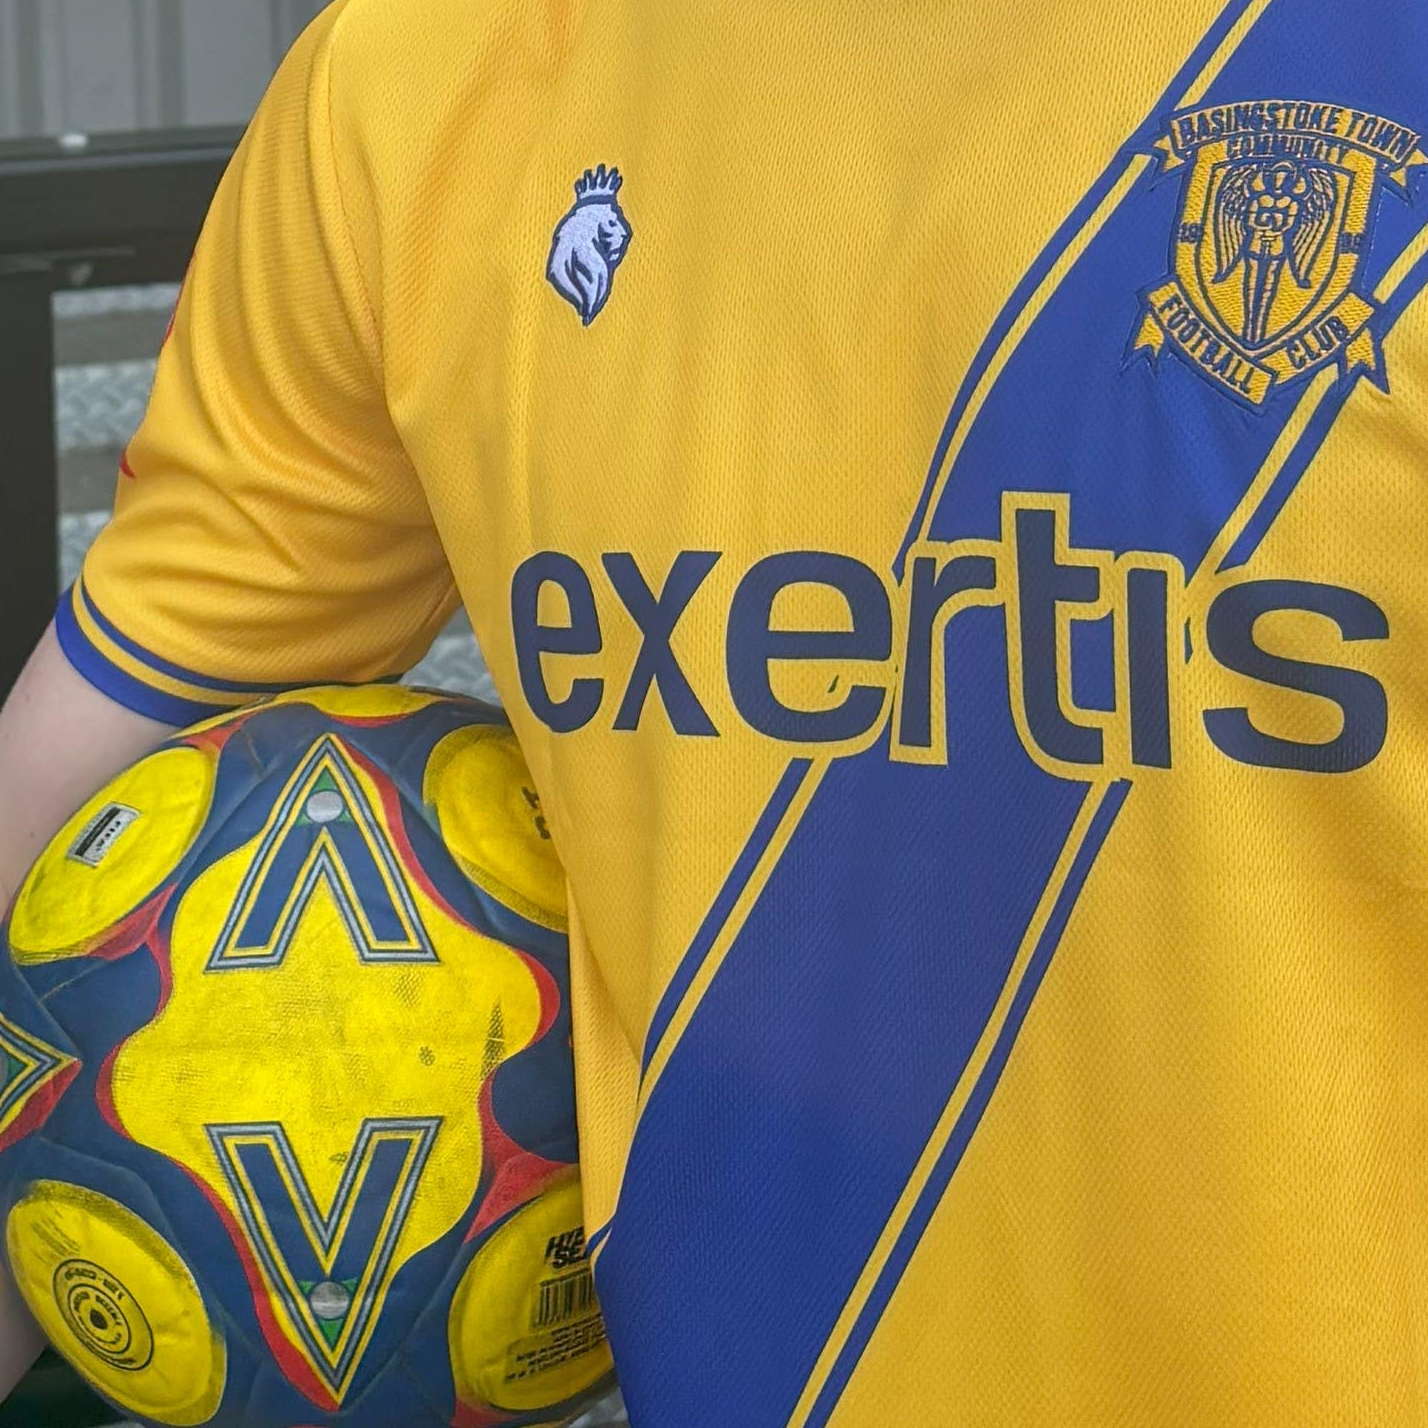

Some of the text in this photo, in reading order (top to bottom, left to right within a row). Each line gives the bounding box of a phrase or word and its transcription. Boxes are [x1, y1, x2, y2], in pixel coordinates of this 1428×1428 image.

[1176, 100, 1418, 162] BASINGSTOKE TOWN
[1157, 292, 1349, 394] FOOTBALL CLUB
[511, 506, 1391, 774] exertis
